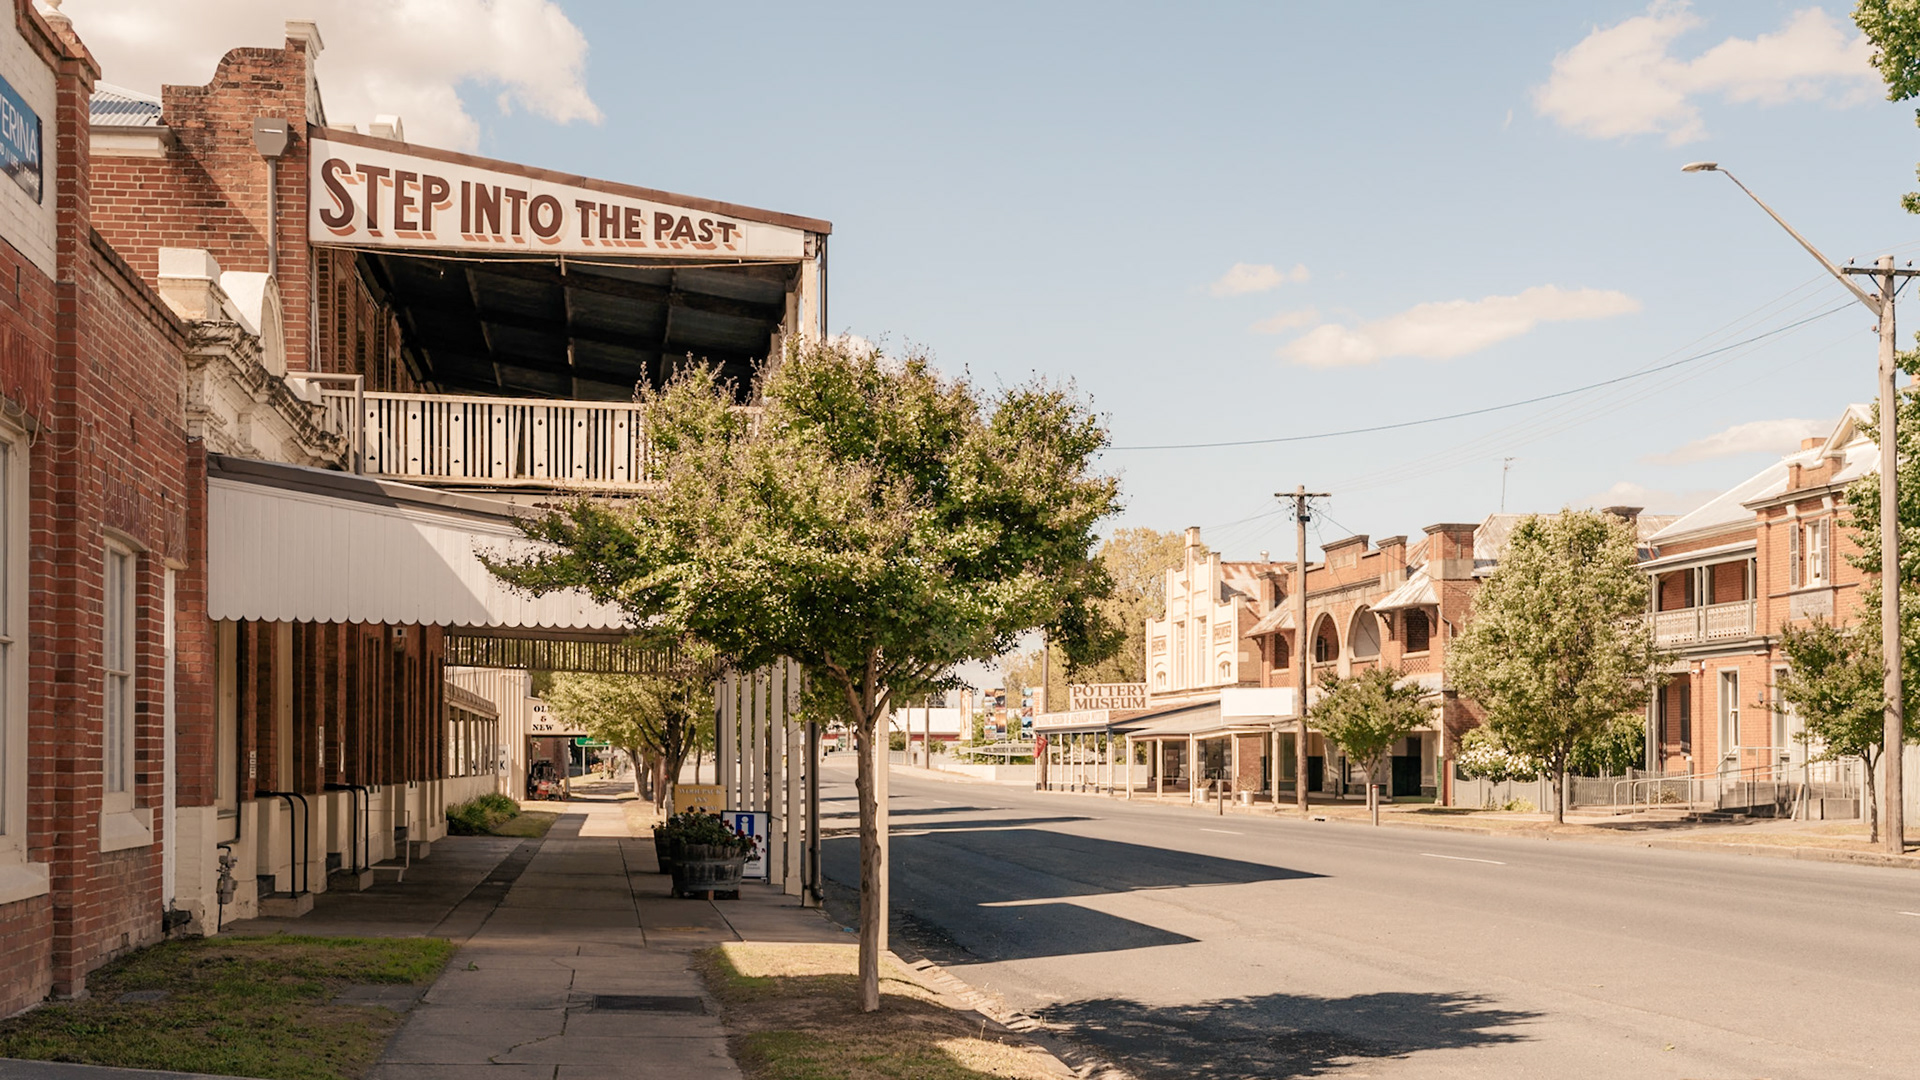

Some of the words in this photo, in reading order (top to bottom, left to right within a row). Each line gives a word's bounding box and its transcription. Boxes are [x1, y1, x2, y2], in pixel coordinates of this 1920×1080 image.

[319, 158, 451, 238] STEP
[460, 180, 563, 243] INTO
[575, 199, 643, 244] THE
[654, 212, 740, 249] PAST
[1073, 684, 1148, 697] POTTERY
[1074, 696, 1147, 710] MUSEUM
